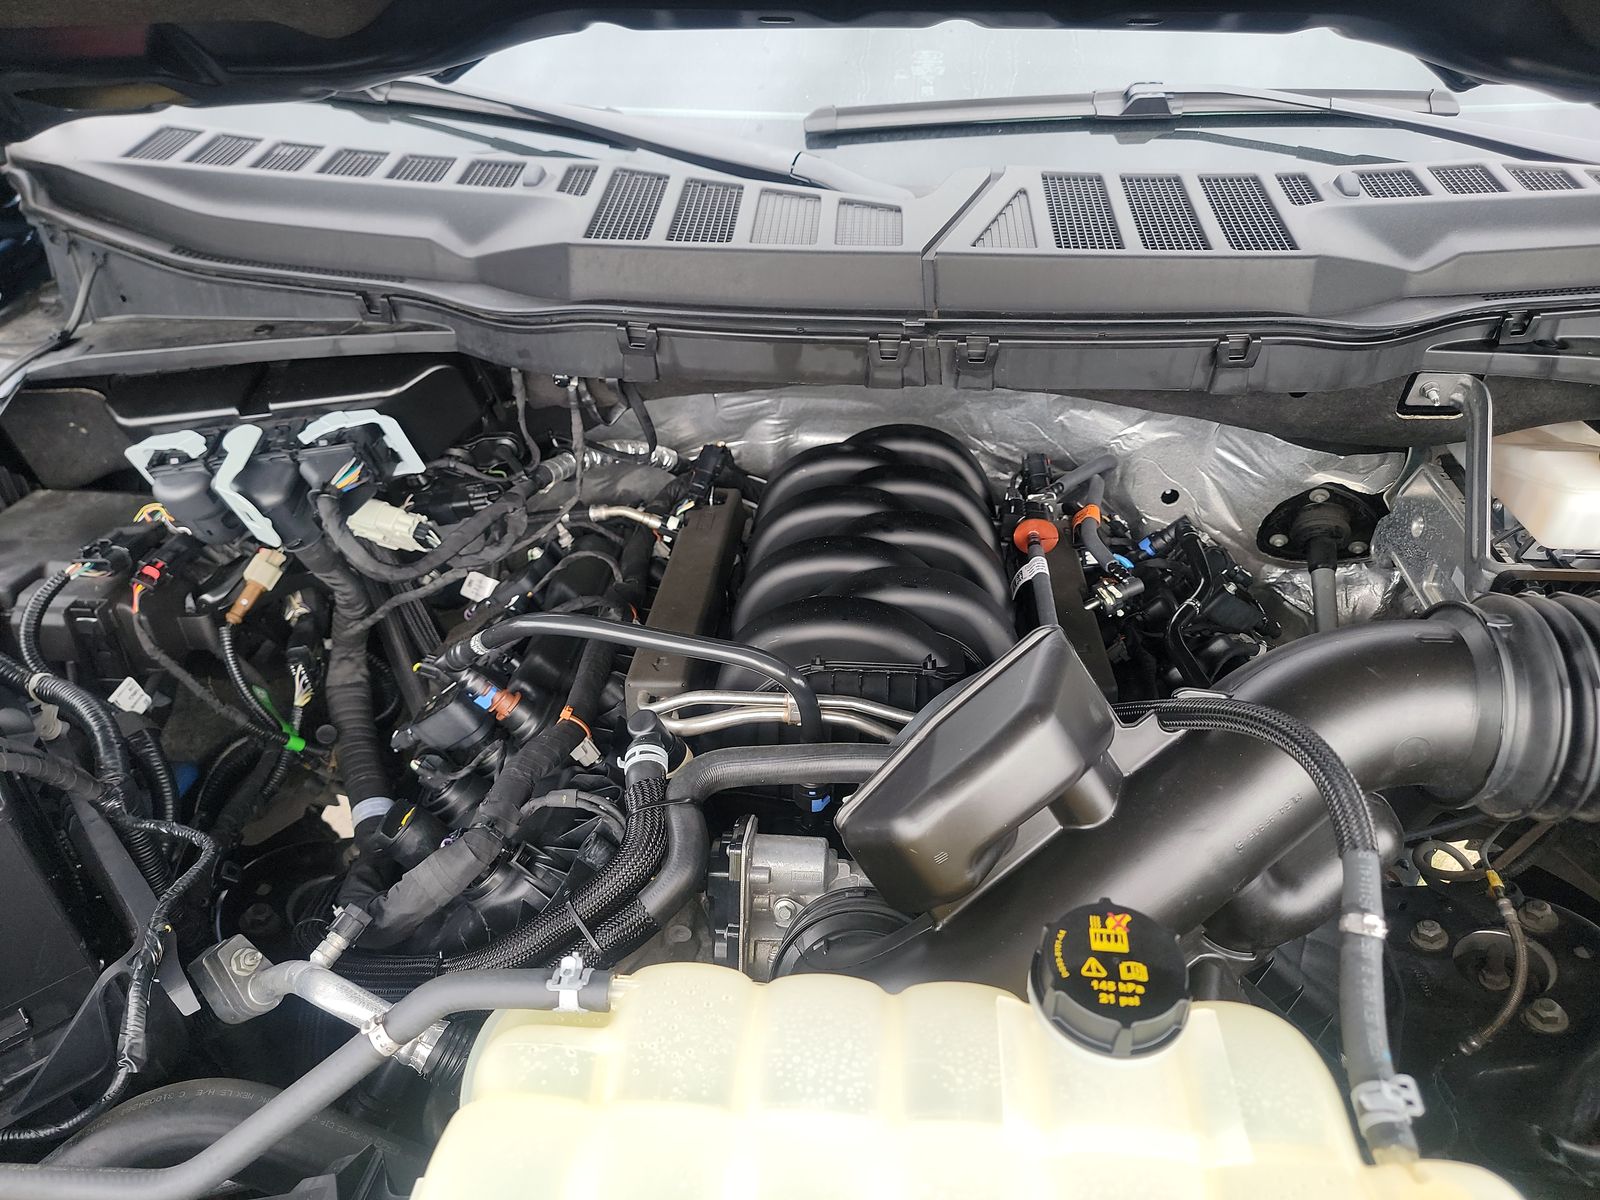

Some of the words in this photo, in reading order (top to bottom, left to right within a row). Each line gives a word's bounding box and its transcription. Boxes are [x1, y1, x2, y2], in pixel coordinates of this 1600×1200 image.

[1118, 981, 1146, 995] kPa
[1098, 992, 1116, 1005] 21
[1119, 995, 1141, 1008] psi
